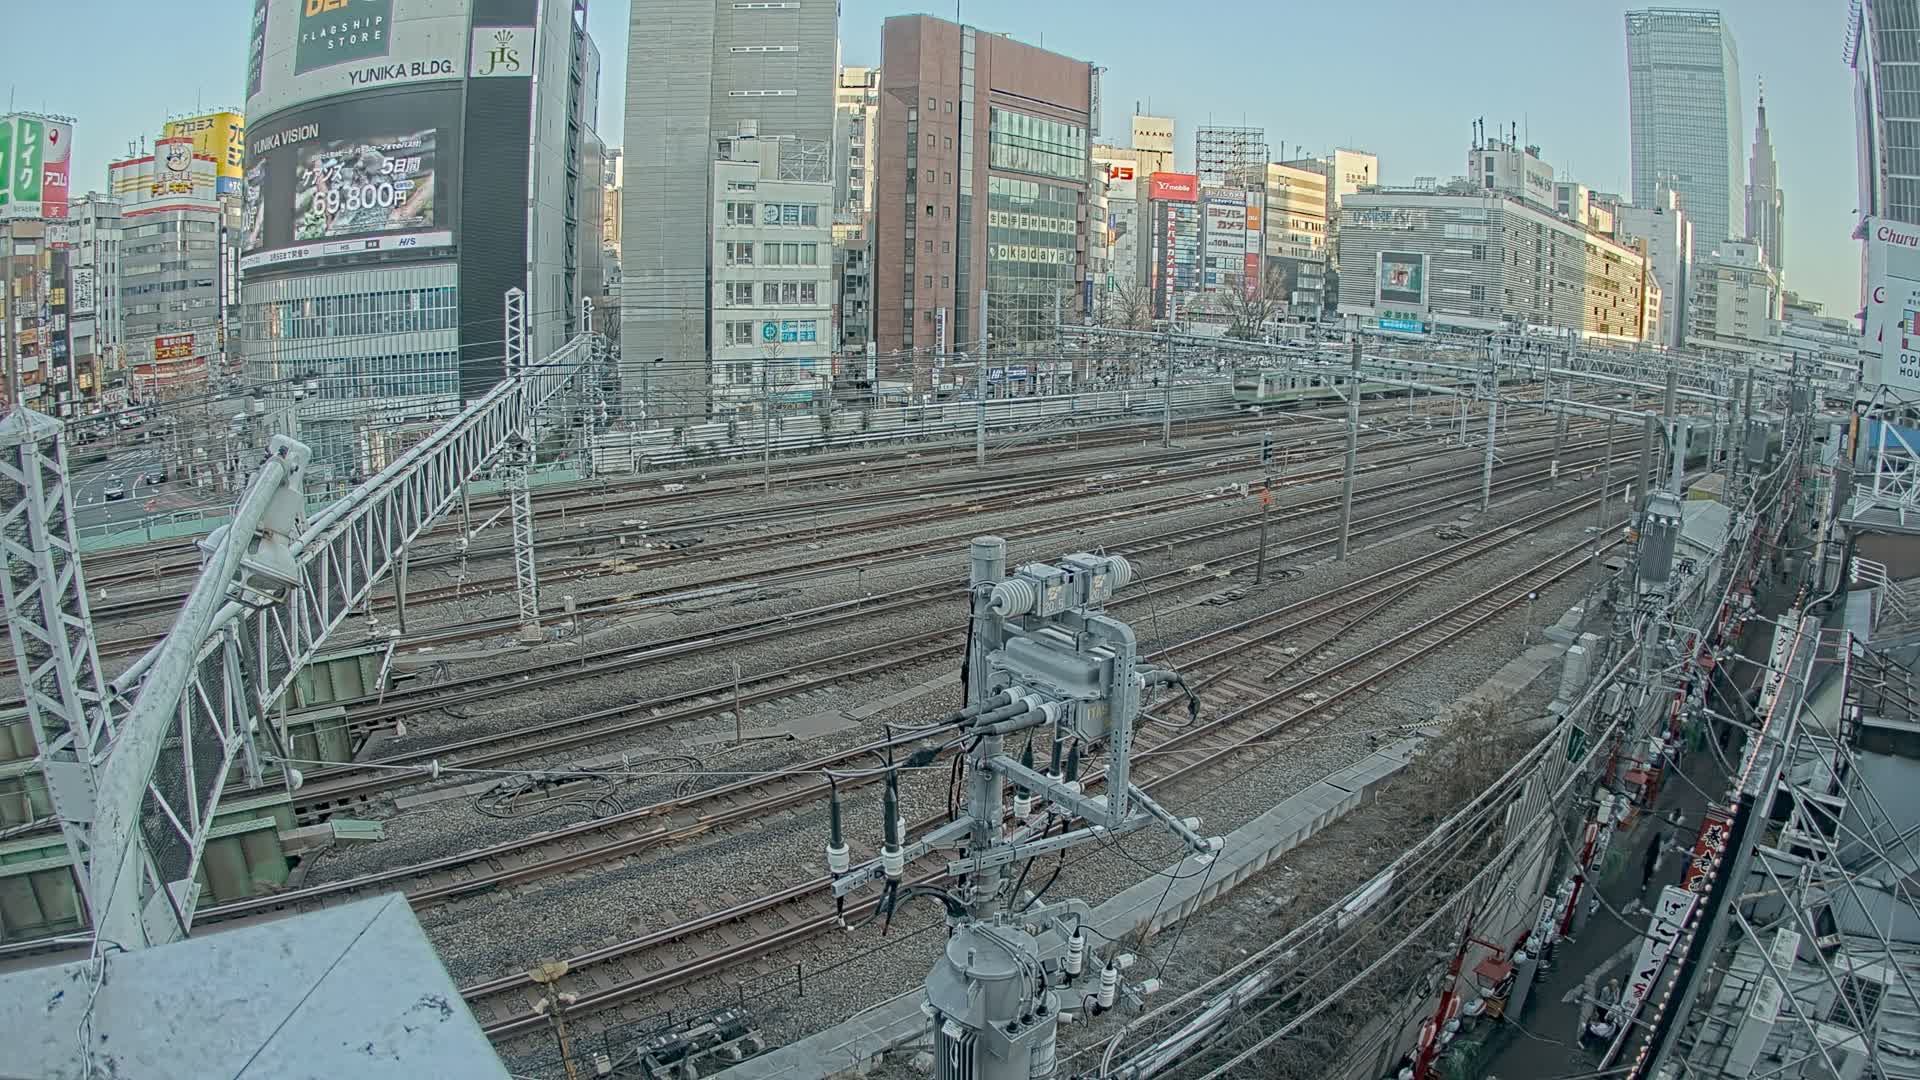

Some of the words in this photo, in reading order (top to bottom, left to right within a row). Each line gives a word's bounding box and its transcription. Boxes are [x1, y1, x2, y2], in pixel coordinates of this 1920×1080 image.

[303, 16, 382, 43] FLAGSHIP
[328, 30, 382, 49] STORE
[349, 63, 407, 85] YUNIKA
[411, 60, 455, 77] BLDG.
[175, 119, 214, 136] プロミス
[1134, 130, 1173, 138] TAKANO
[254, 134, 281, 155] YUNIKA
[281, 123, 319, 145] VISION
[20, 123, 36, 190] レイク
[380, 156, 421, 175] 5日間
[45, 171, 67, 186] アコム
[1106, 167, 1134, 181] メラ
[313, 182, 407, 216] 69,800円
[1878, 226, 1919, 247] Churu
[1000, 246, 1065, 263] okadaya
